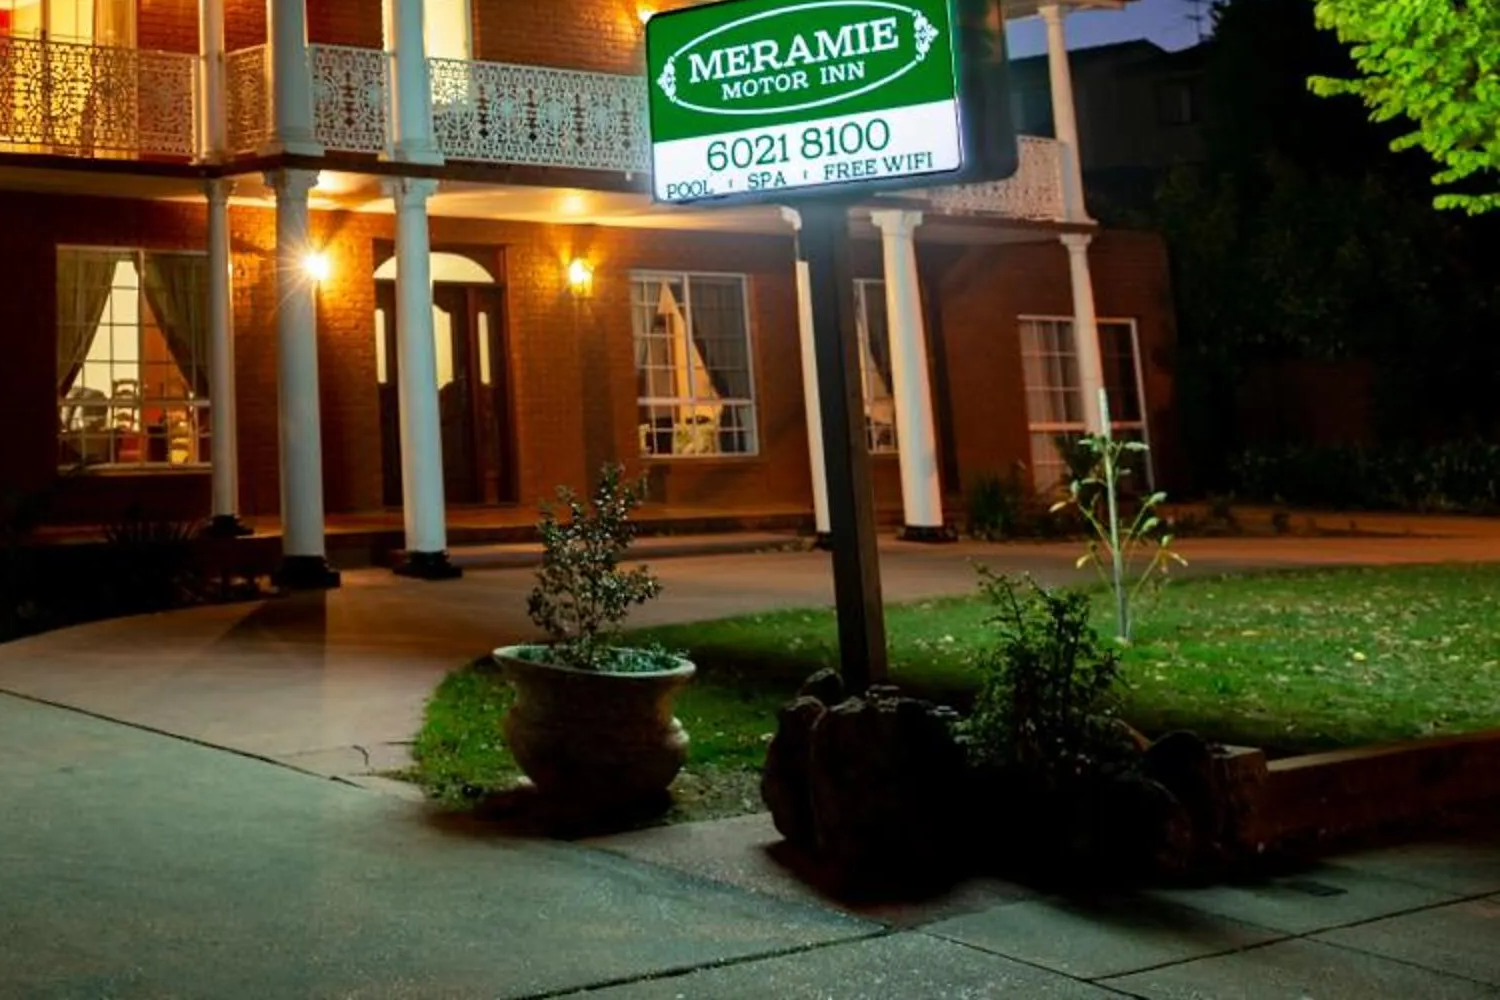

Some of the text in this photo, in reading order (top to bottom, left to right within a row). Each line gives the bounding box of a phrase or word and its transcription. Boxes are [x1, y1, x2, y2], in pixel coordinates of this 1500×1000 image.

[688, 17, 899, 83] MERAMIE
[721, 61, 866, 101] MOTOR INN
[706, 118, 890, 172] 6021 8100
[666, 151, 934, 199] POOL SPA FREE WIFI
